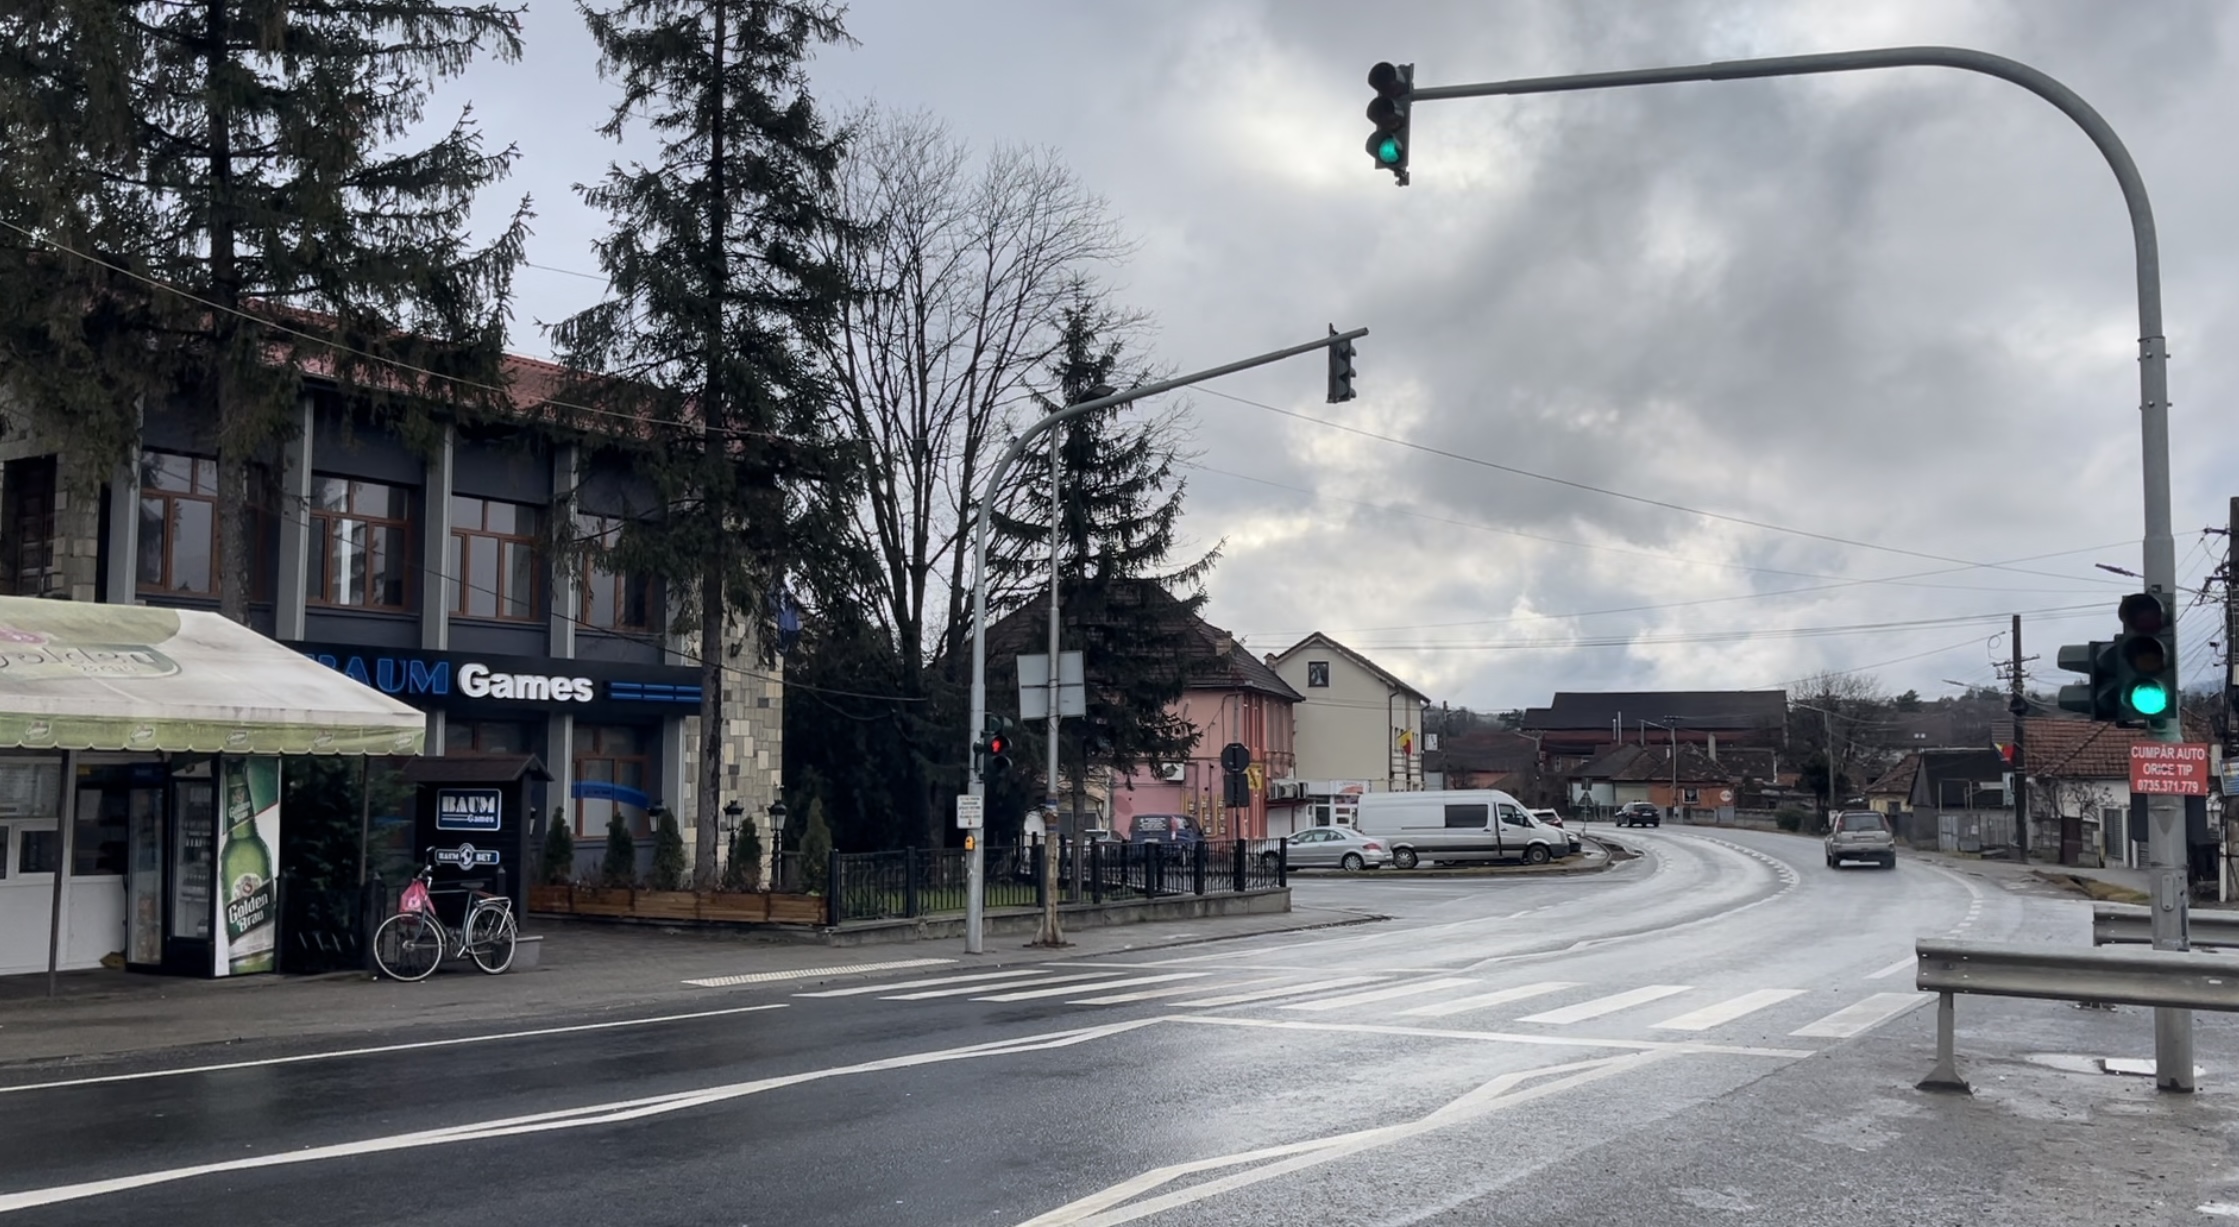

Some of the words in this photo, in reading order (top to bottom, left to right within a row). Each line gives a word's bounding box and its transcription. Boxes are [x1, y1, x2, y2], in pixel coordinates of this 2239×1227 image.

[457, 662, 594, 703] Games
[2176, 748, 2206, 761] AUTO
[2142, 763, 2175, 776] ORICE
[2176, 764, 2193, 776] TIP
[2137, 779, 2199, 793] 0735.371.779
[442, 796, 496, 813] BAUM
[467, 813, 495, 823] Games
[228, 893, 269, 924] Golden
